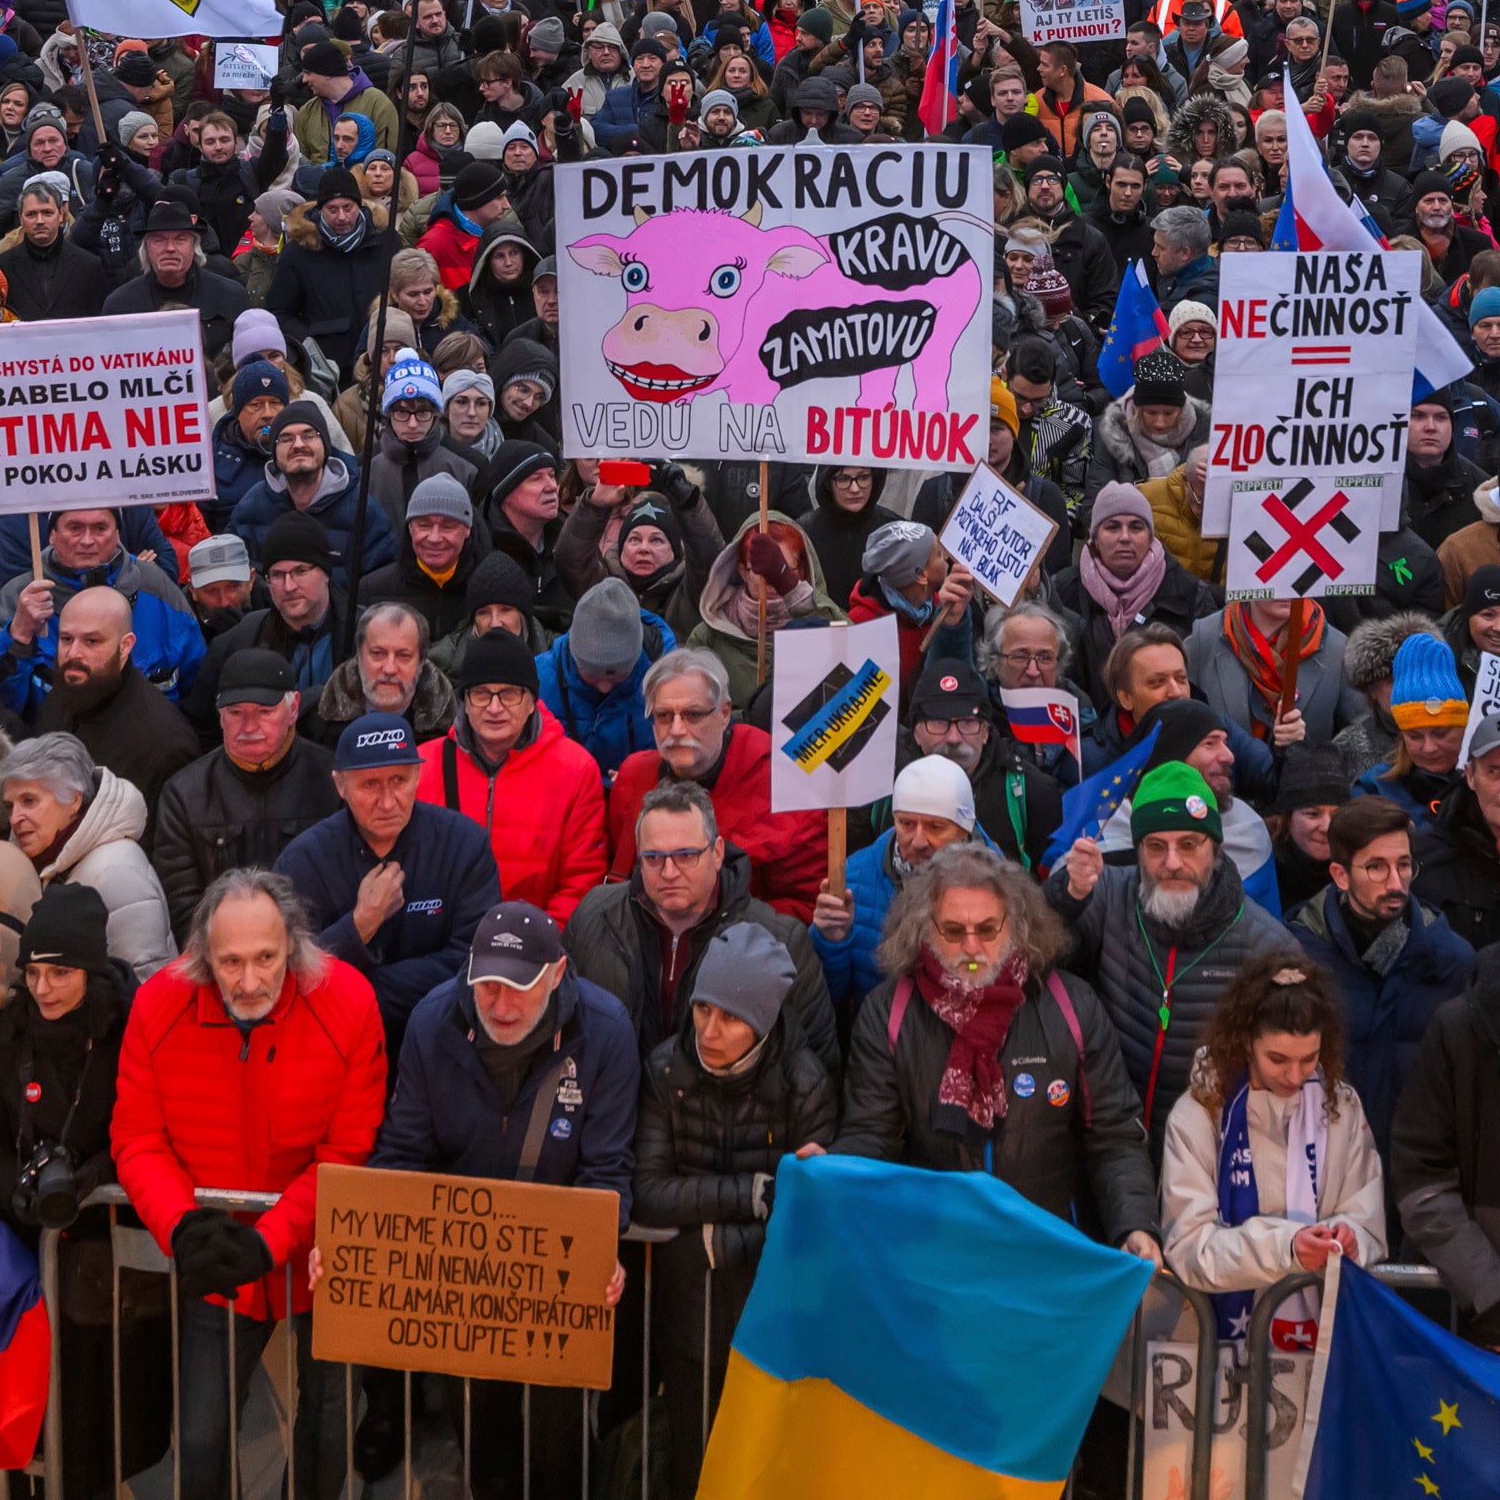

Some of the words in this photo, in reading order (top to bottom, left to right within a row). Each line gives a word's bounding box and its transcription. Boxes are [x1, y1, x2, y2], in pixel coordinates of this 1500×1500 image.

[1035, 14, 1053, 28] AJ
[1057, 11, 1073, 25] TY
[1077, 6, 1114, 22] LETÍŠ
[581, 150, 971, 220] DEMOKRACIU
[837, 224, 962, 276] KRAVU
[1294, 252, 1388, 295] NAŠA
[1220, 291, 1412, 339] NEČINNOSŤ
[69, 356, 95, 373] DO
[100, 347, 195, 371] VATIKÁNU
[762, 306, 936, 378] ZAMATOVÚ
[120, 369, 195, 399] MLČÍ
[1294, 377, 1354, 419] ICH
[124, 402, 202, 449] NIE
[572, 398, 692, 450] VEDÚ
[718, 402, 786, 454] NA
[806, 402, 980, 465] BITÚNOK
[1211, 413, 1408, 472] ZLOČINNOSŤ
[5, 462, 87, 486] POKOJ
[120, 452, 203, 479] LÁSKU
[1234, 480, 1283, 492] DEPPERT!
[1335, 476, 1384, 488] DEPPERT!
[331, 1207, 369, 1238] MY
[374, 1212, 437, 1246] VIEME
[442, 1219, 487, 1251] KTO
[496, 1224, 549, 1257] STE
[332, 1245, 377, 1276] STE
[388, 1246, 436, 1281] PLNÍ
[438, 1253, 544, 1292] NENÁVISTI
[328, 1276, 373, 1309] STE
[378, 1282, 465, 1320] KLAMÁRI,
[388, 1317, 517, 1357] ODSTÚPTE
